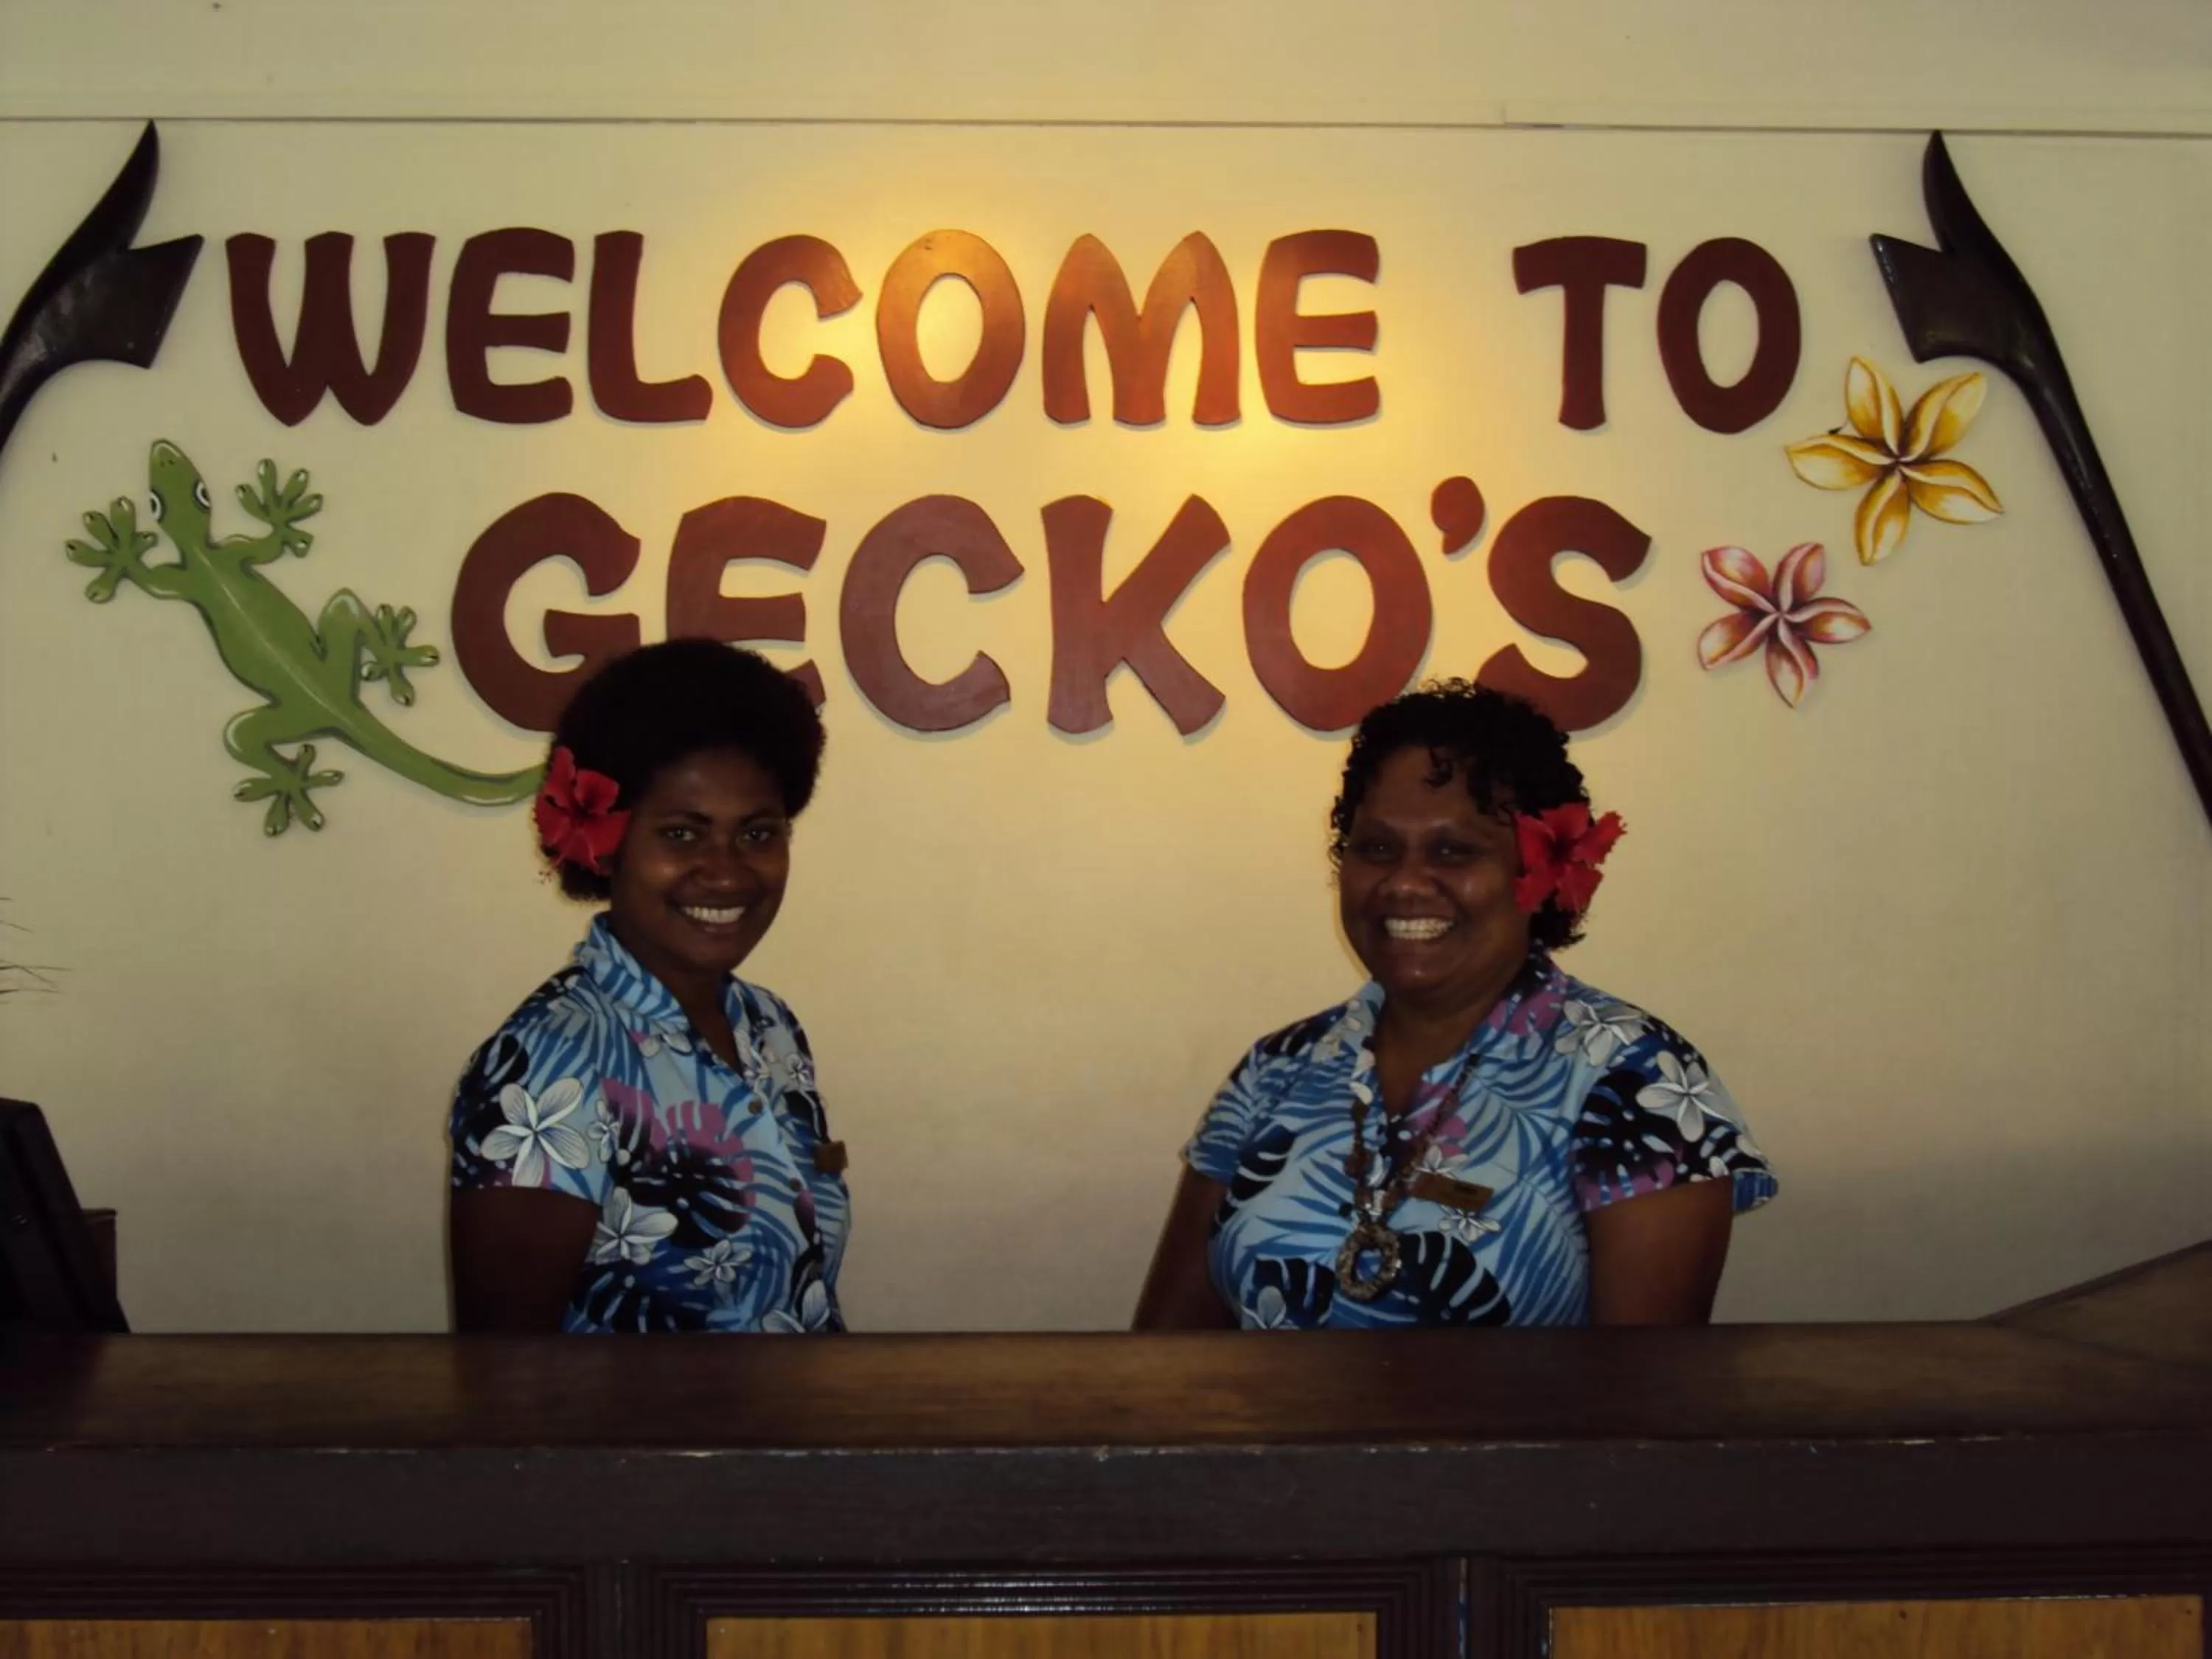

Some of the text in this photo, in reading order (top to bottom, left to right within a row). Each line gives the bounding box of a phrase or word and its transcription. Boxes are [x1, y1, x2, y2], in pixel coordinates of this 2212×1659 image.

[226, 226, 1801, 434] WELCOME TO
[451, 476, 1651, 734] GECKO'S
